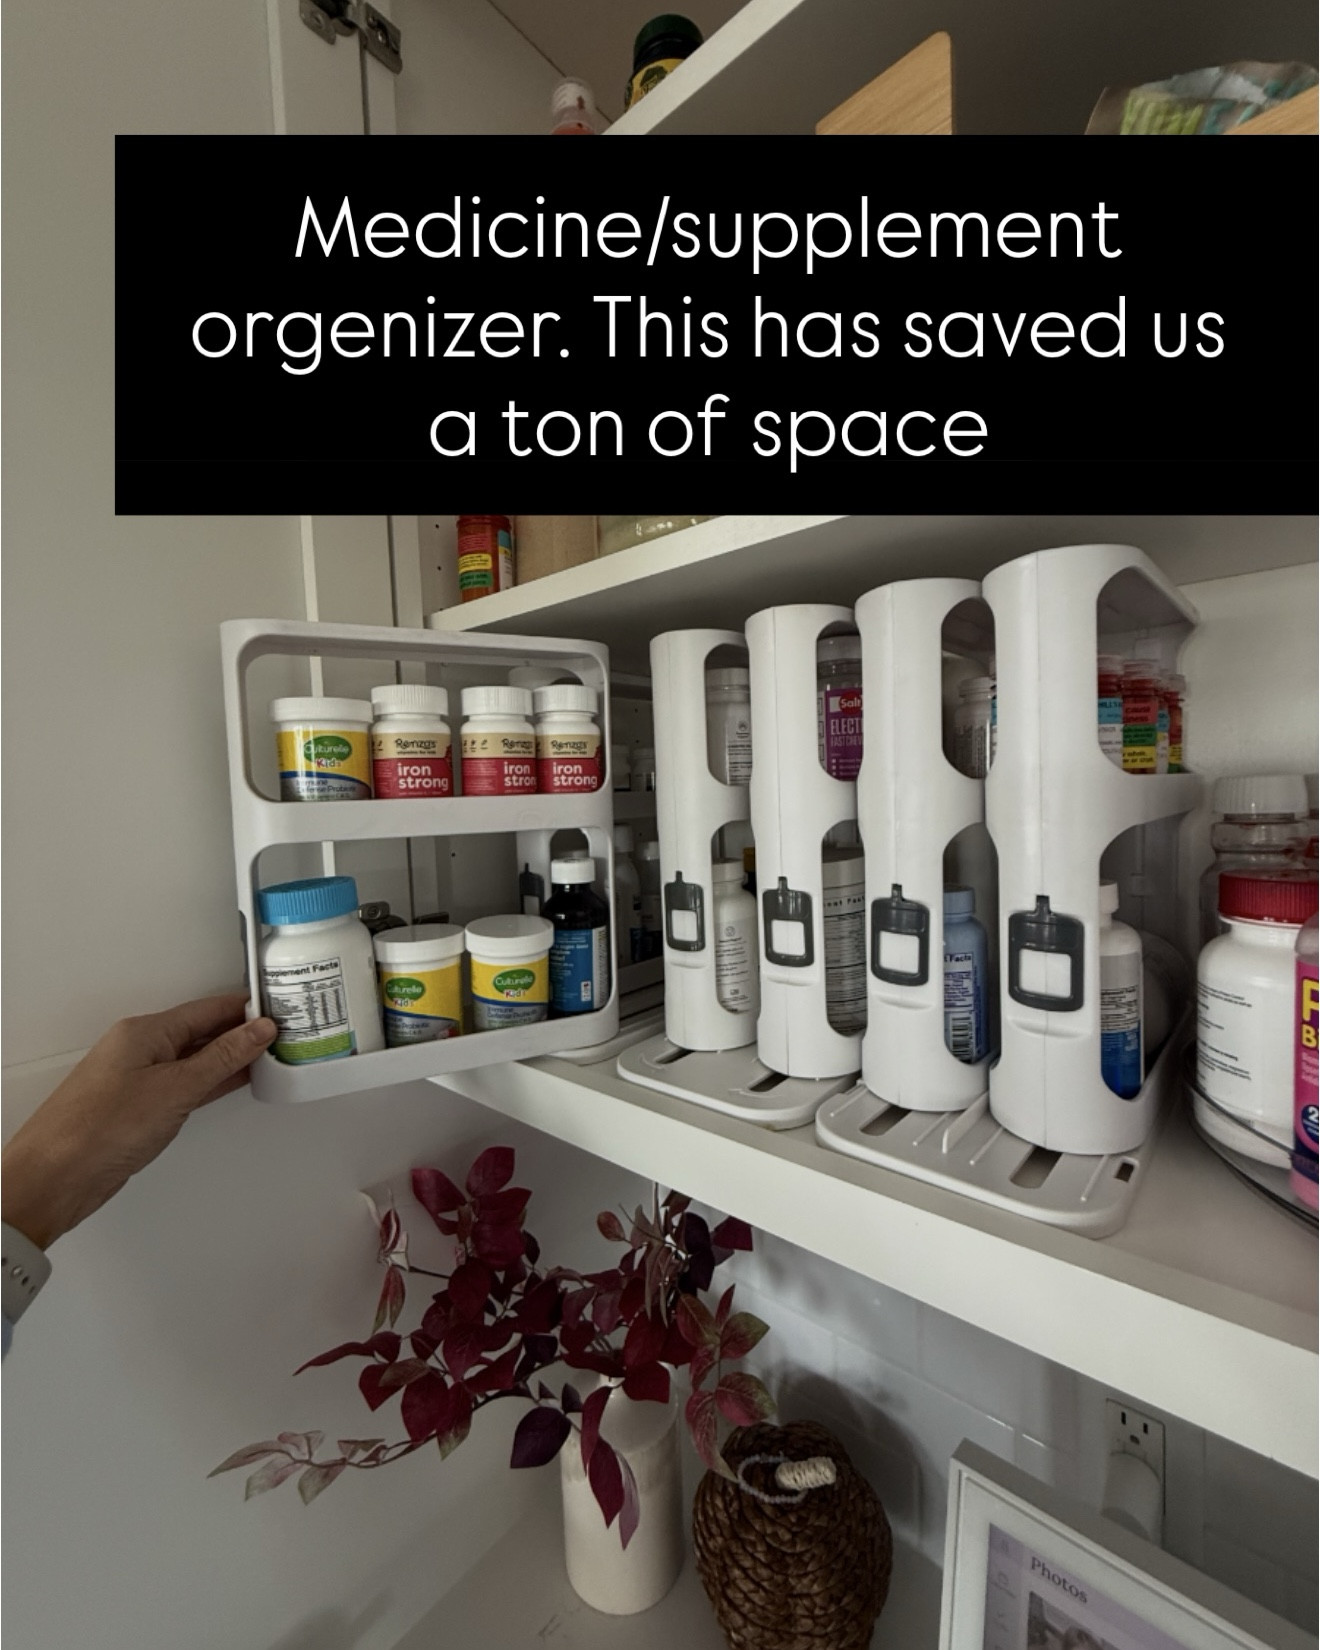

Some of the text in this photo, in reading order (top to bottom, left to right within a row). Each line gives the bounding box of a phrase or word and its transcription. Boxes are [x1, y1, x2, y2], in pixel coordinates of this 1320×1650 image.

[397, 763, 432, 777] iron
[503, 761, 531, 775] iron
[552, 762, 583, 775] iron
[398, 776, 449, 792] strong
[552, 774, 598, 788] strong
[312, 961, 339, 973] Facts
[1031, 1556, 1087, 1603] Photos
